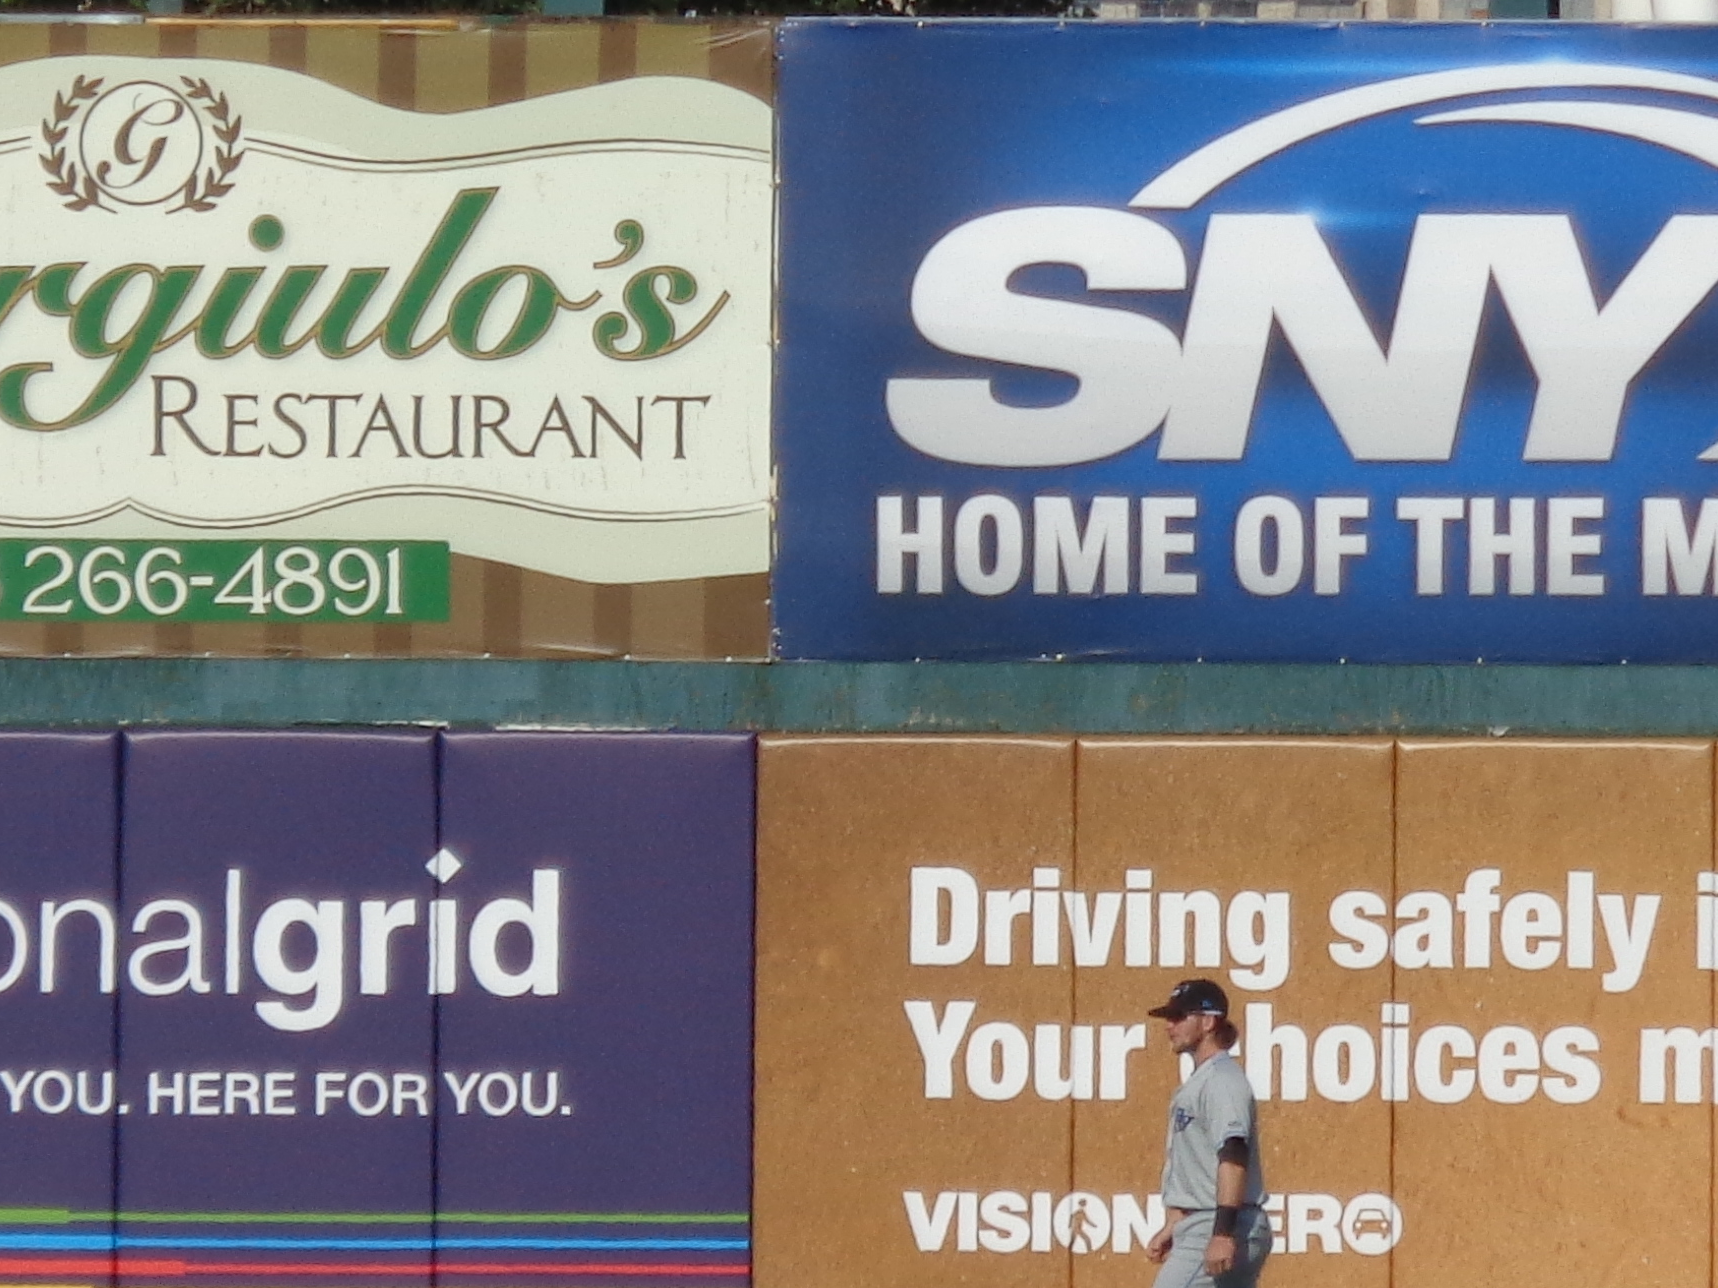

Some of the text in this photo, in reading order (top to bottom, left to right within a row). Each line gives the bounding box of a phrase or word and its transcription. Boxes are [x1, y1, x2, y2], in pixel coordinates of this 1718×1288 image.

[150, 375, 711, 462] RESTAURANT
[22, 544, 402, 618] 266-4891
[876, 495, 1197, 595] HOME
[1234, 496, 1370, 596] OF
[1396, 497, 1605, 596] THE
[908, 864, 1291, 992] Driving
[1327, 865, 1662, 994] safely
[148, 1070, 296, 1116] HERE
[315, 1071, 430, 1117] FOR
[442, 1071, 573, 1118] YOU.
[903, 999, 1146, 1103] Your
[1179, 1001, 1603, 1106] hoices
[902, 1190, 1403, 1257] VISION ERO
